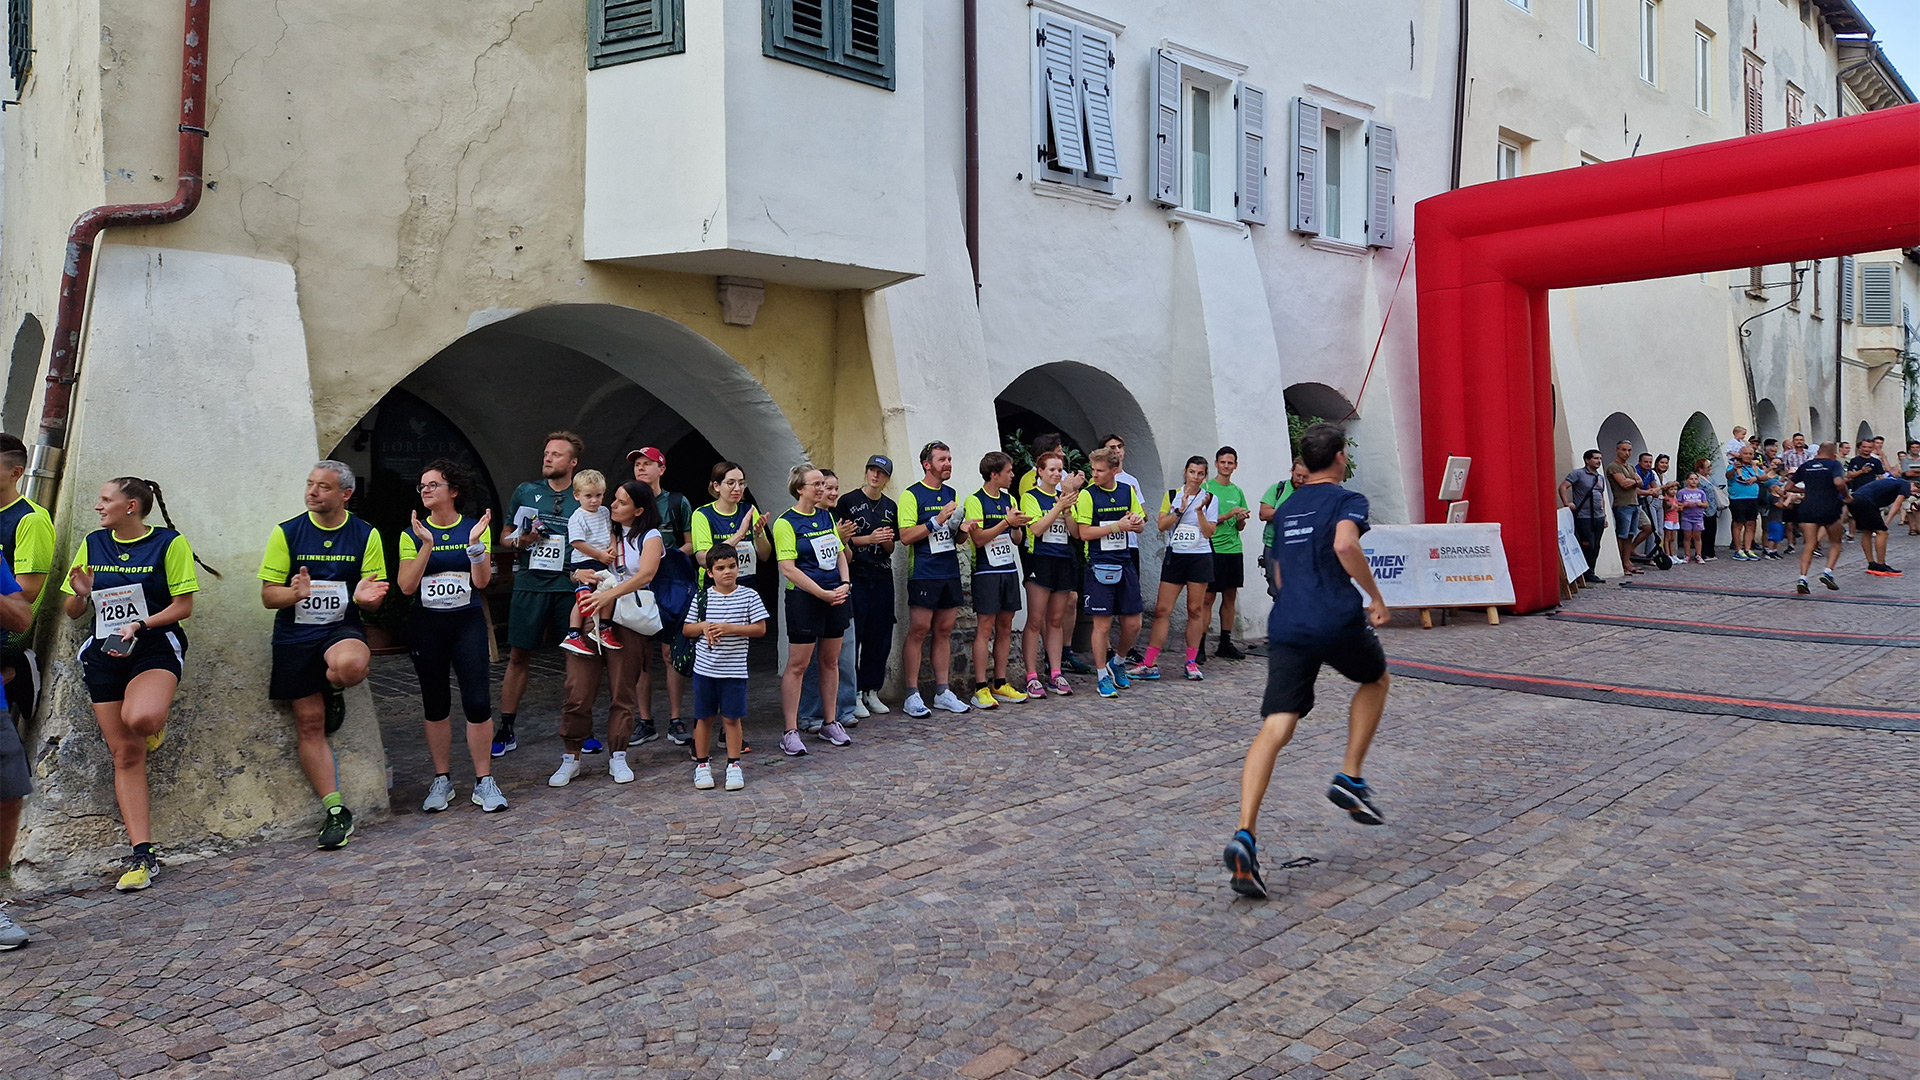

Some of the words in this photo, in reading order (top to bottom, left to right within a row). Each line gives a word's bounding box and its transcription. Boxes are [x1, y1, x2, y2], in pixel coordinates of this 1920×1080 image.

[382, 441, 458, 453] FOREVER
[933, 531, 950, 542] 132
[1440, 546, 1491, 555] SPARKASSE
[1445, 574, 1494, 582] ATHESIA
[427, 584, 466, 597] 300A
[301, 596, 340, 610] 301B
[100, 603, 139, 621] 128A
